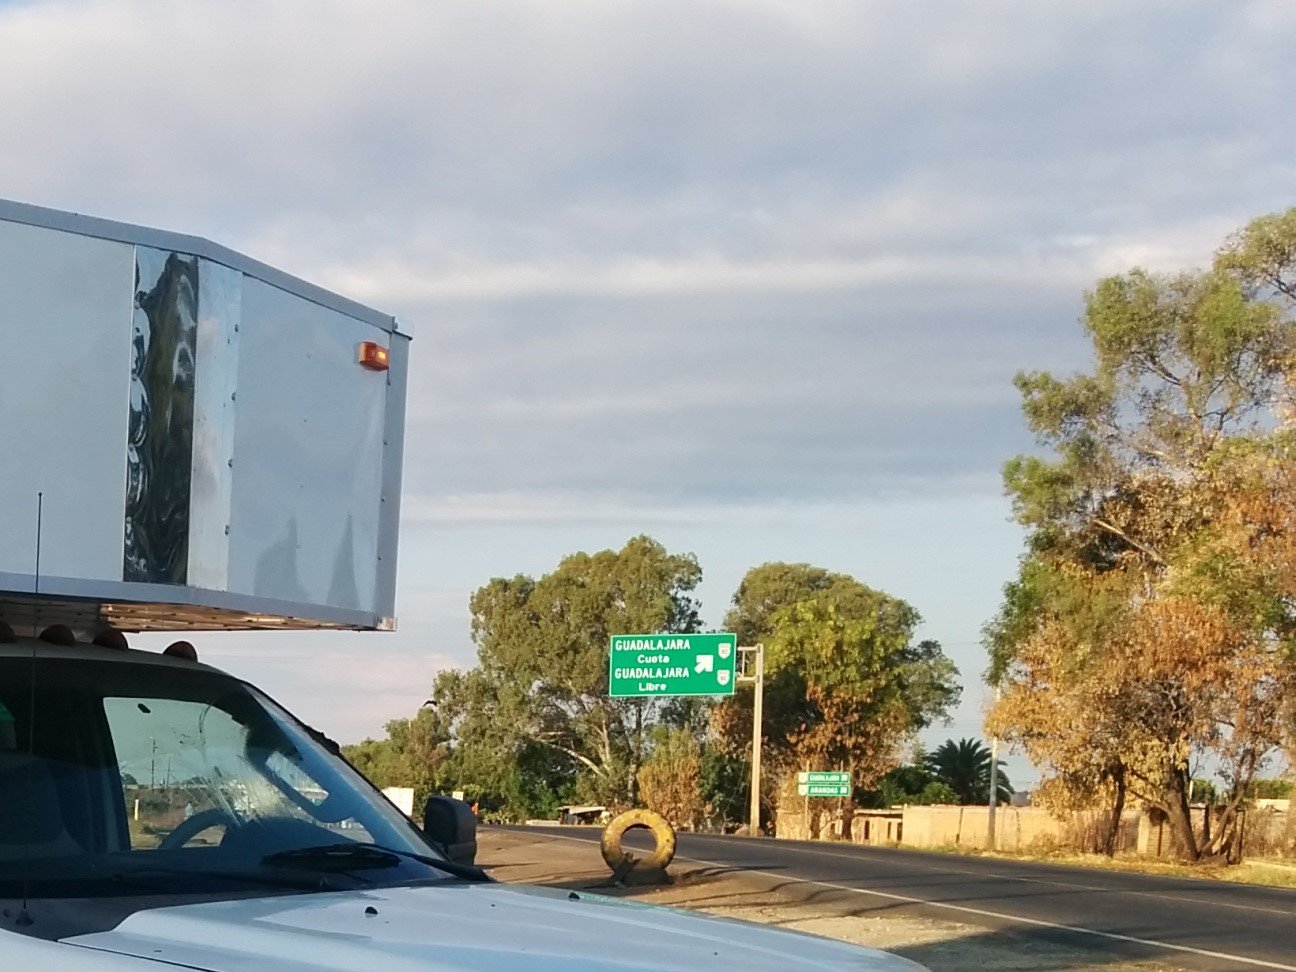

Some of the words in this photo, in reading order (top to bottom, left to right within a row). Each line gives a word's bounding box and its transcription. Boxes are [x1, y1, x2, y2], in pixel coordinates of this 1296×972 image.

[615, 639, 691, 651] GUADALAJARA
[637, 654, 670, 664] Cuota
[614, 667, 690, 679] GUADALAJARA
[638, 682, 667, 692] Libre
